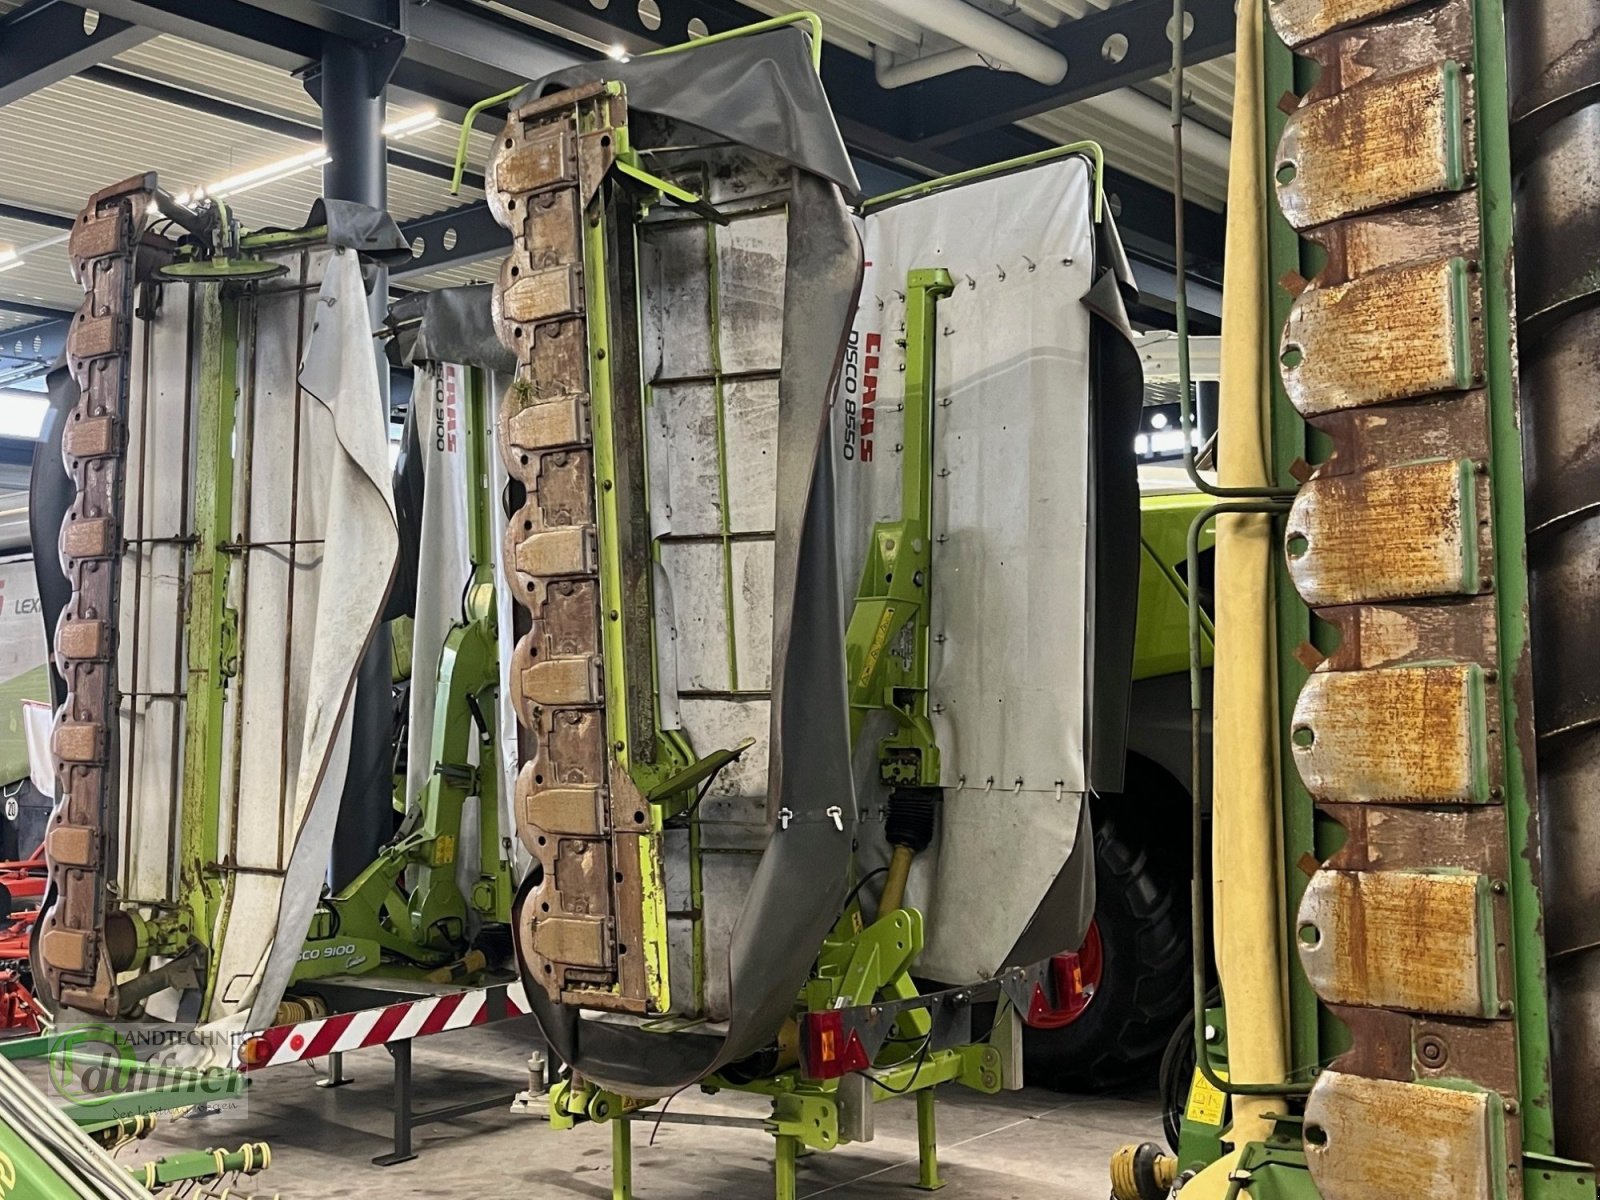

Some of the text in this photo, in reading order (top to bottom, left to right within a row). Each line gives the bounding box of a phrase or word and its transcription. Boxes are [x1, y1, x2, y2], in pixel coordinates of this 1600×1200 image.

[843, 330, 859, 461] DISCO 8550
[861, 333, 881, 462] CLAAS
[436, 408, 445, 452] 9100
[15, 598, 42, 614] LEX
[324, 944, 356, 958] 9100
